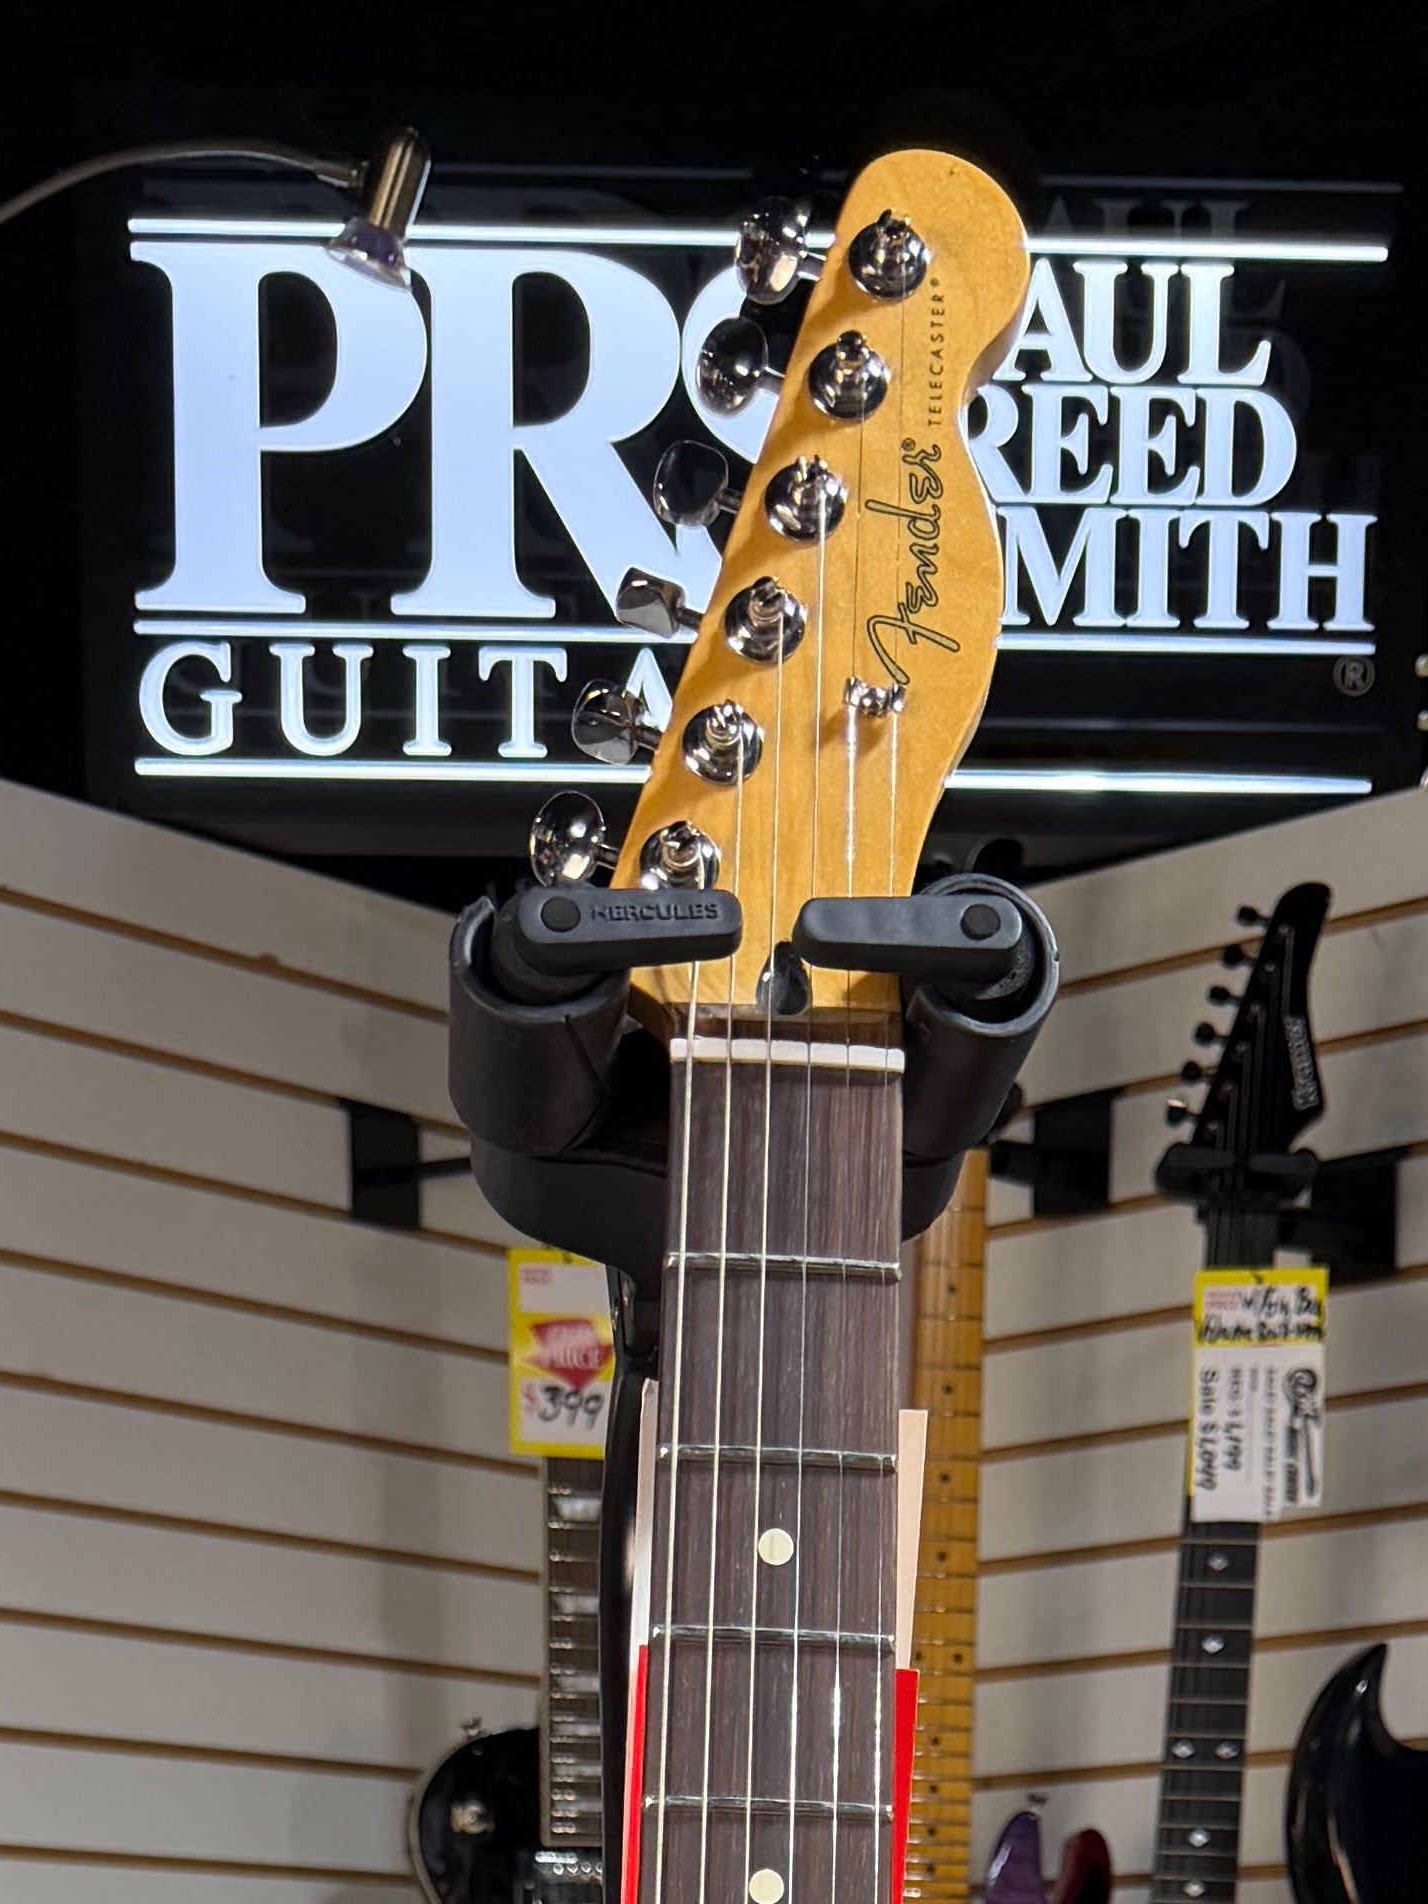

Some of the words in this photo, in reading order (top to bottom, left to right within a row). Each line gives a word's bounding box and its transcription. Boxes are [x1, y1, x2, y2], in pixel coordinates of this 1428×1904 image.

[992, 256, 1272, 387] AUL
[996, 506, 1379, 632] MITH
[138, 641, 673, 757] GUITA
[590, 902, 719, 923] HERCULES
